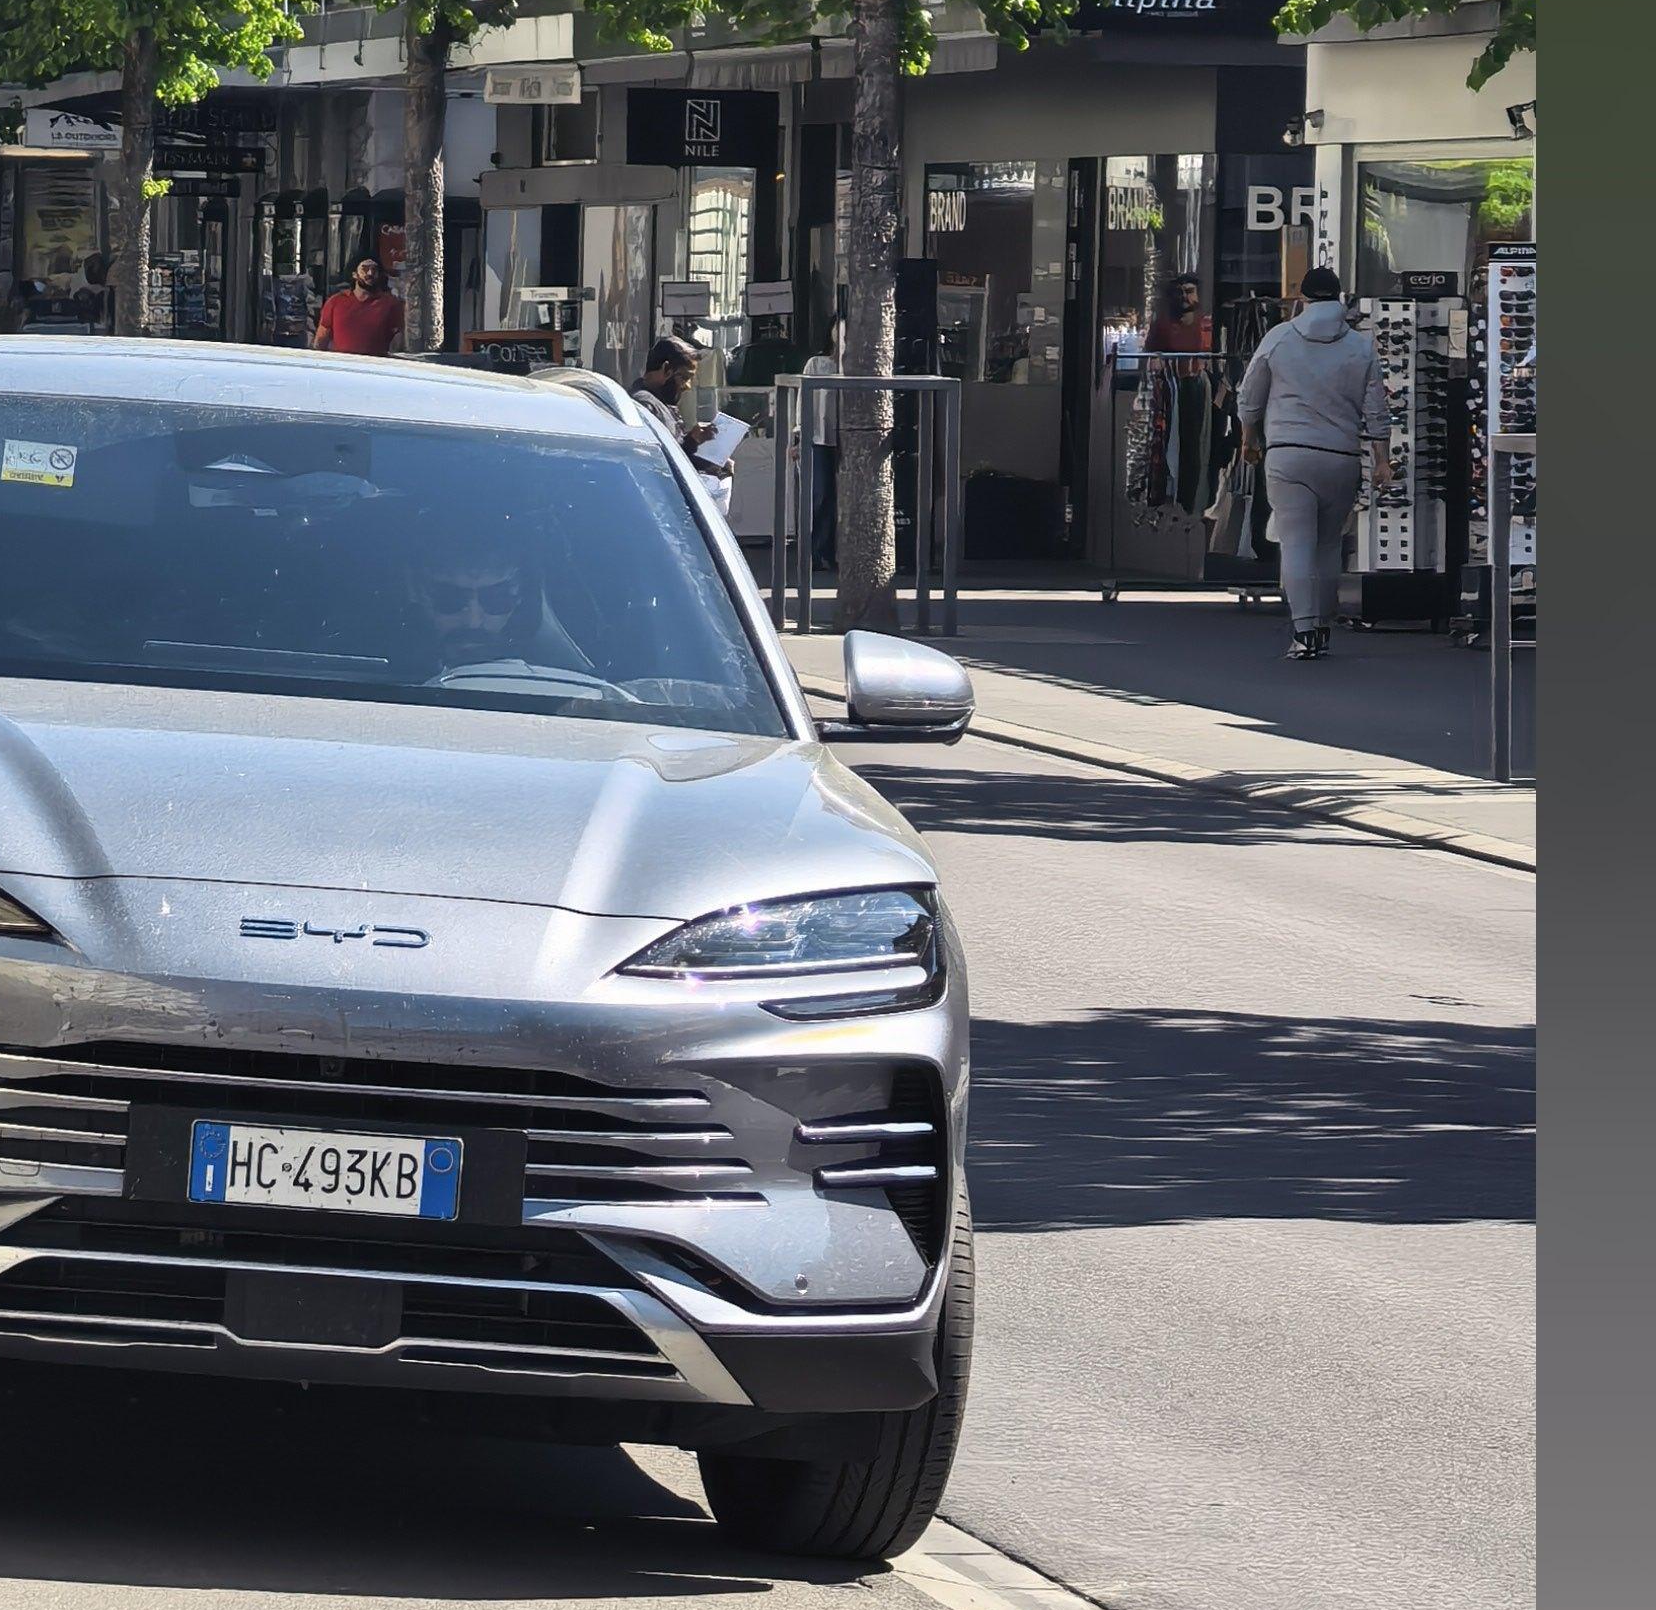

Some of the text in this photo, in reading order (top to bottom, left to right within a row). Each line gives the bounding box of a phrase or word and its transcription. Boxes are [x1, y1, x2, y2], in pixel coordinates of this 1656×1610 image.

[685, 145, 719, 157] NILE
[929, 191, 967, 232] BRAND
[229, 1140, 419, 1200] HC 493KB
